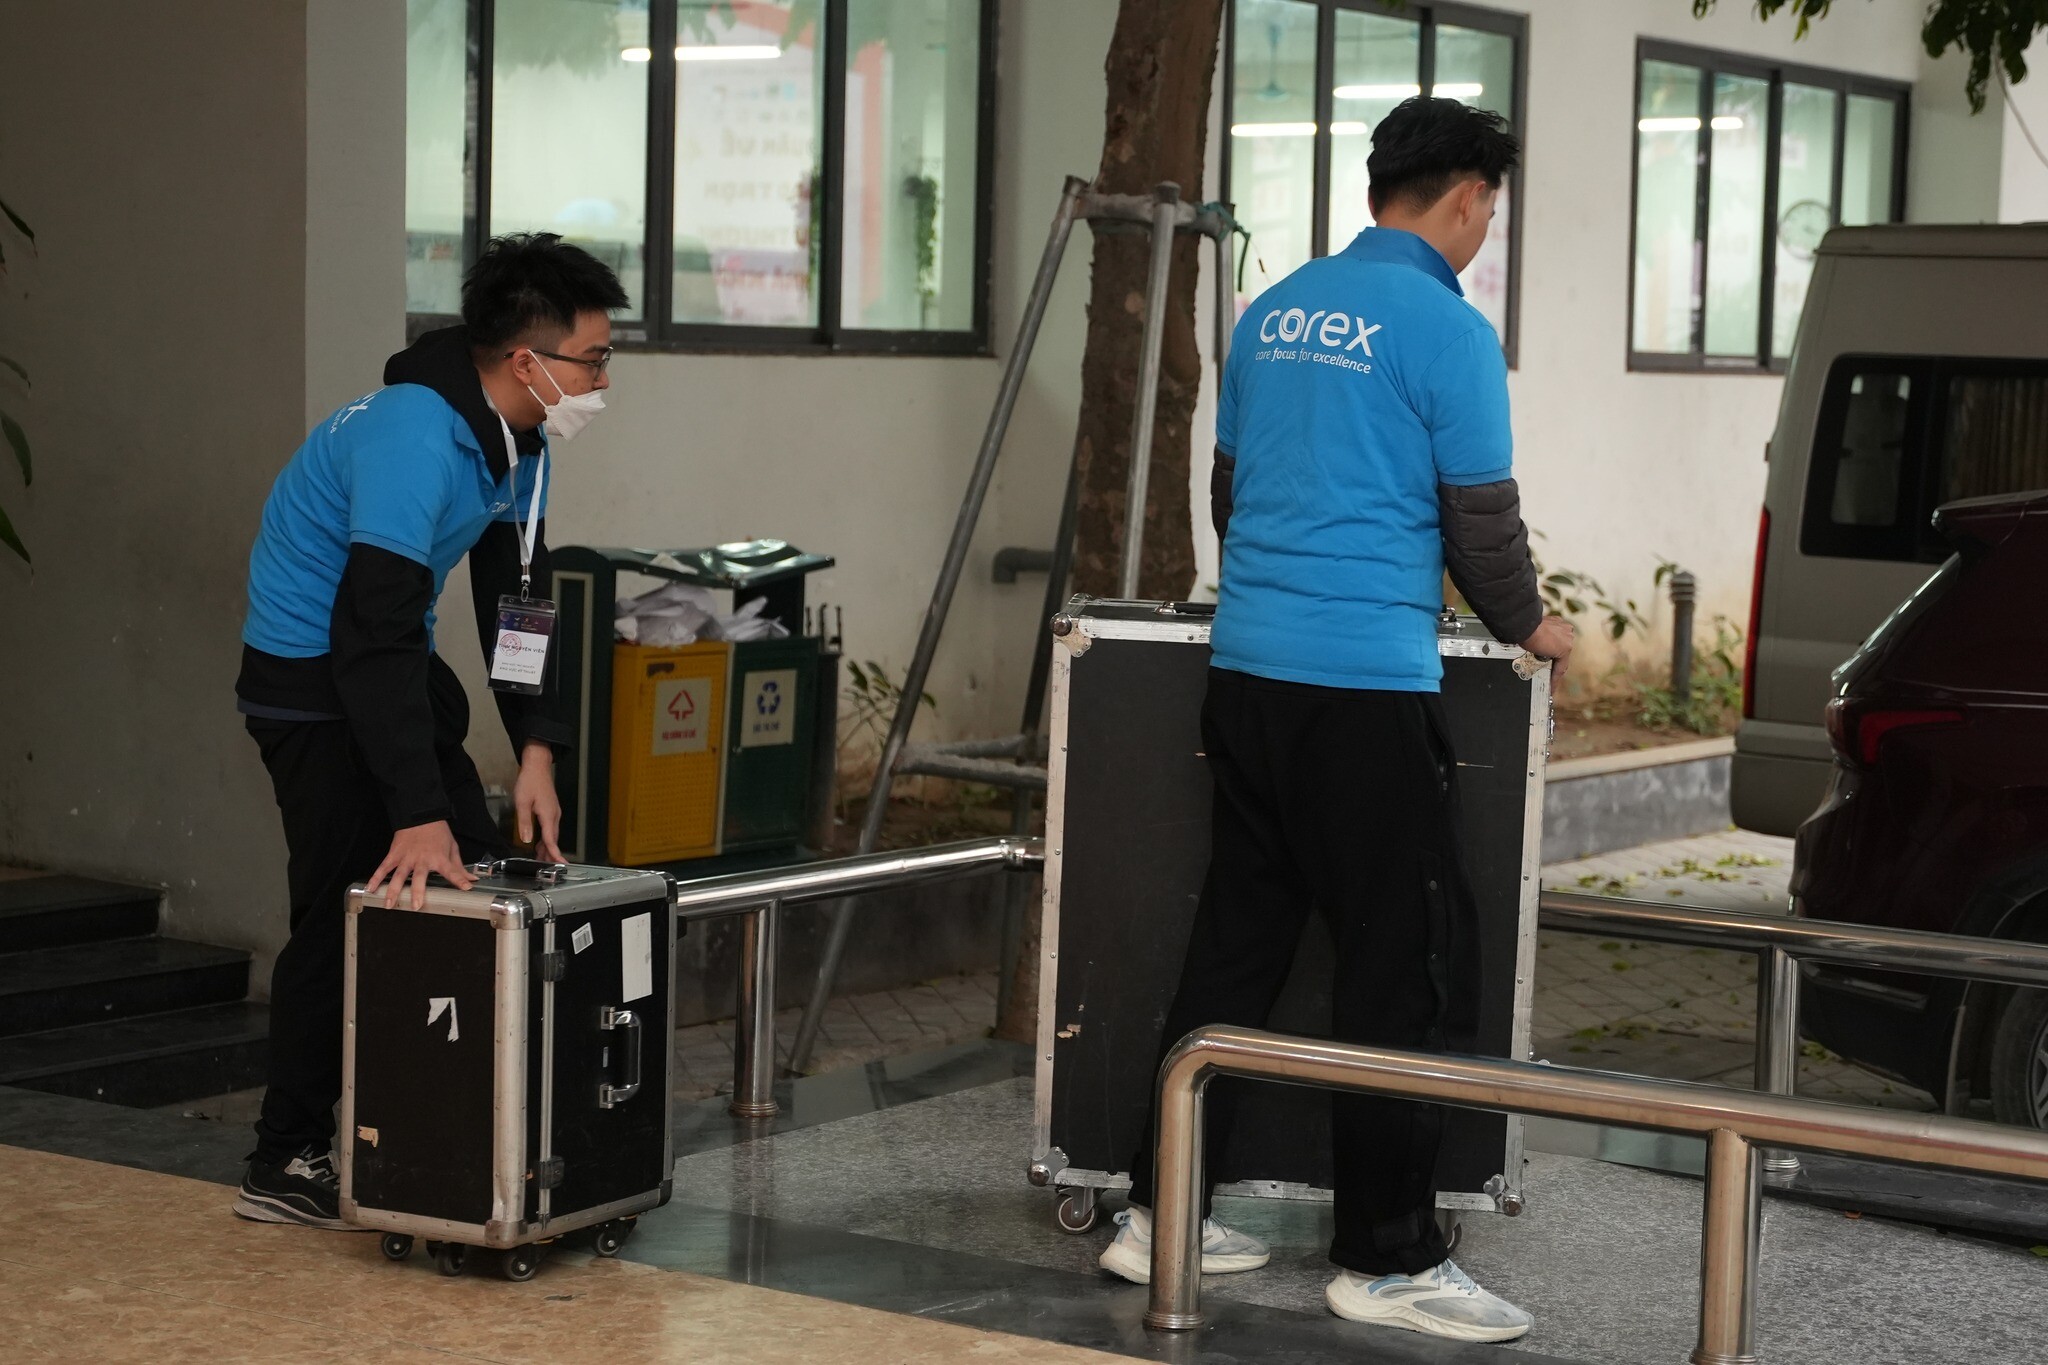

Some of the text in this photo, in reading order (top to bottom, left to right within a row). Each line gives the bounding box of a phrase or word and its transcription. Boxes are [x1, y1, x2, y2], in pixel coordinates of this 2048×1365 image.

[1259, 307, 1383, 358] corex
[1255, 347, 1372, 374] core focus for excellence
